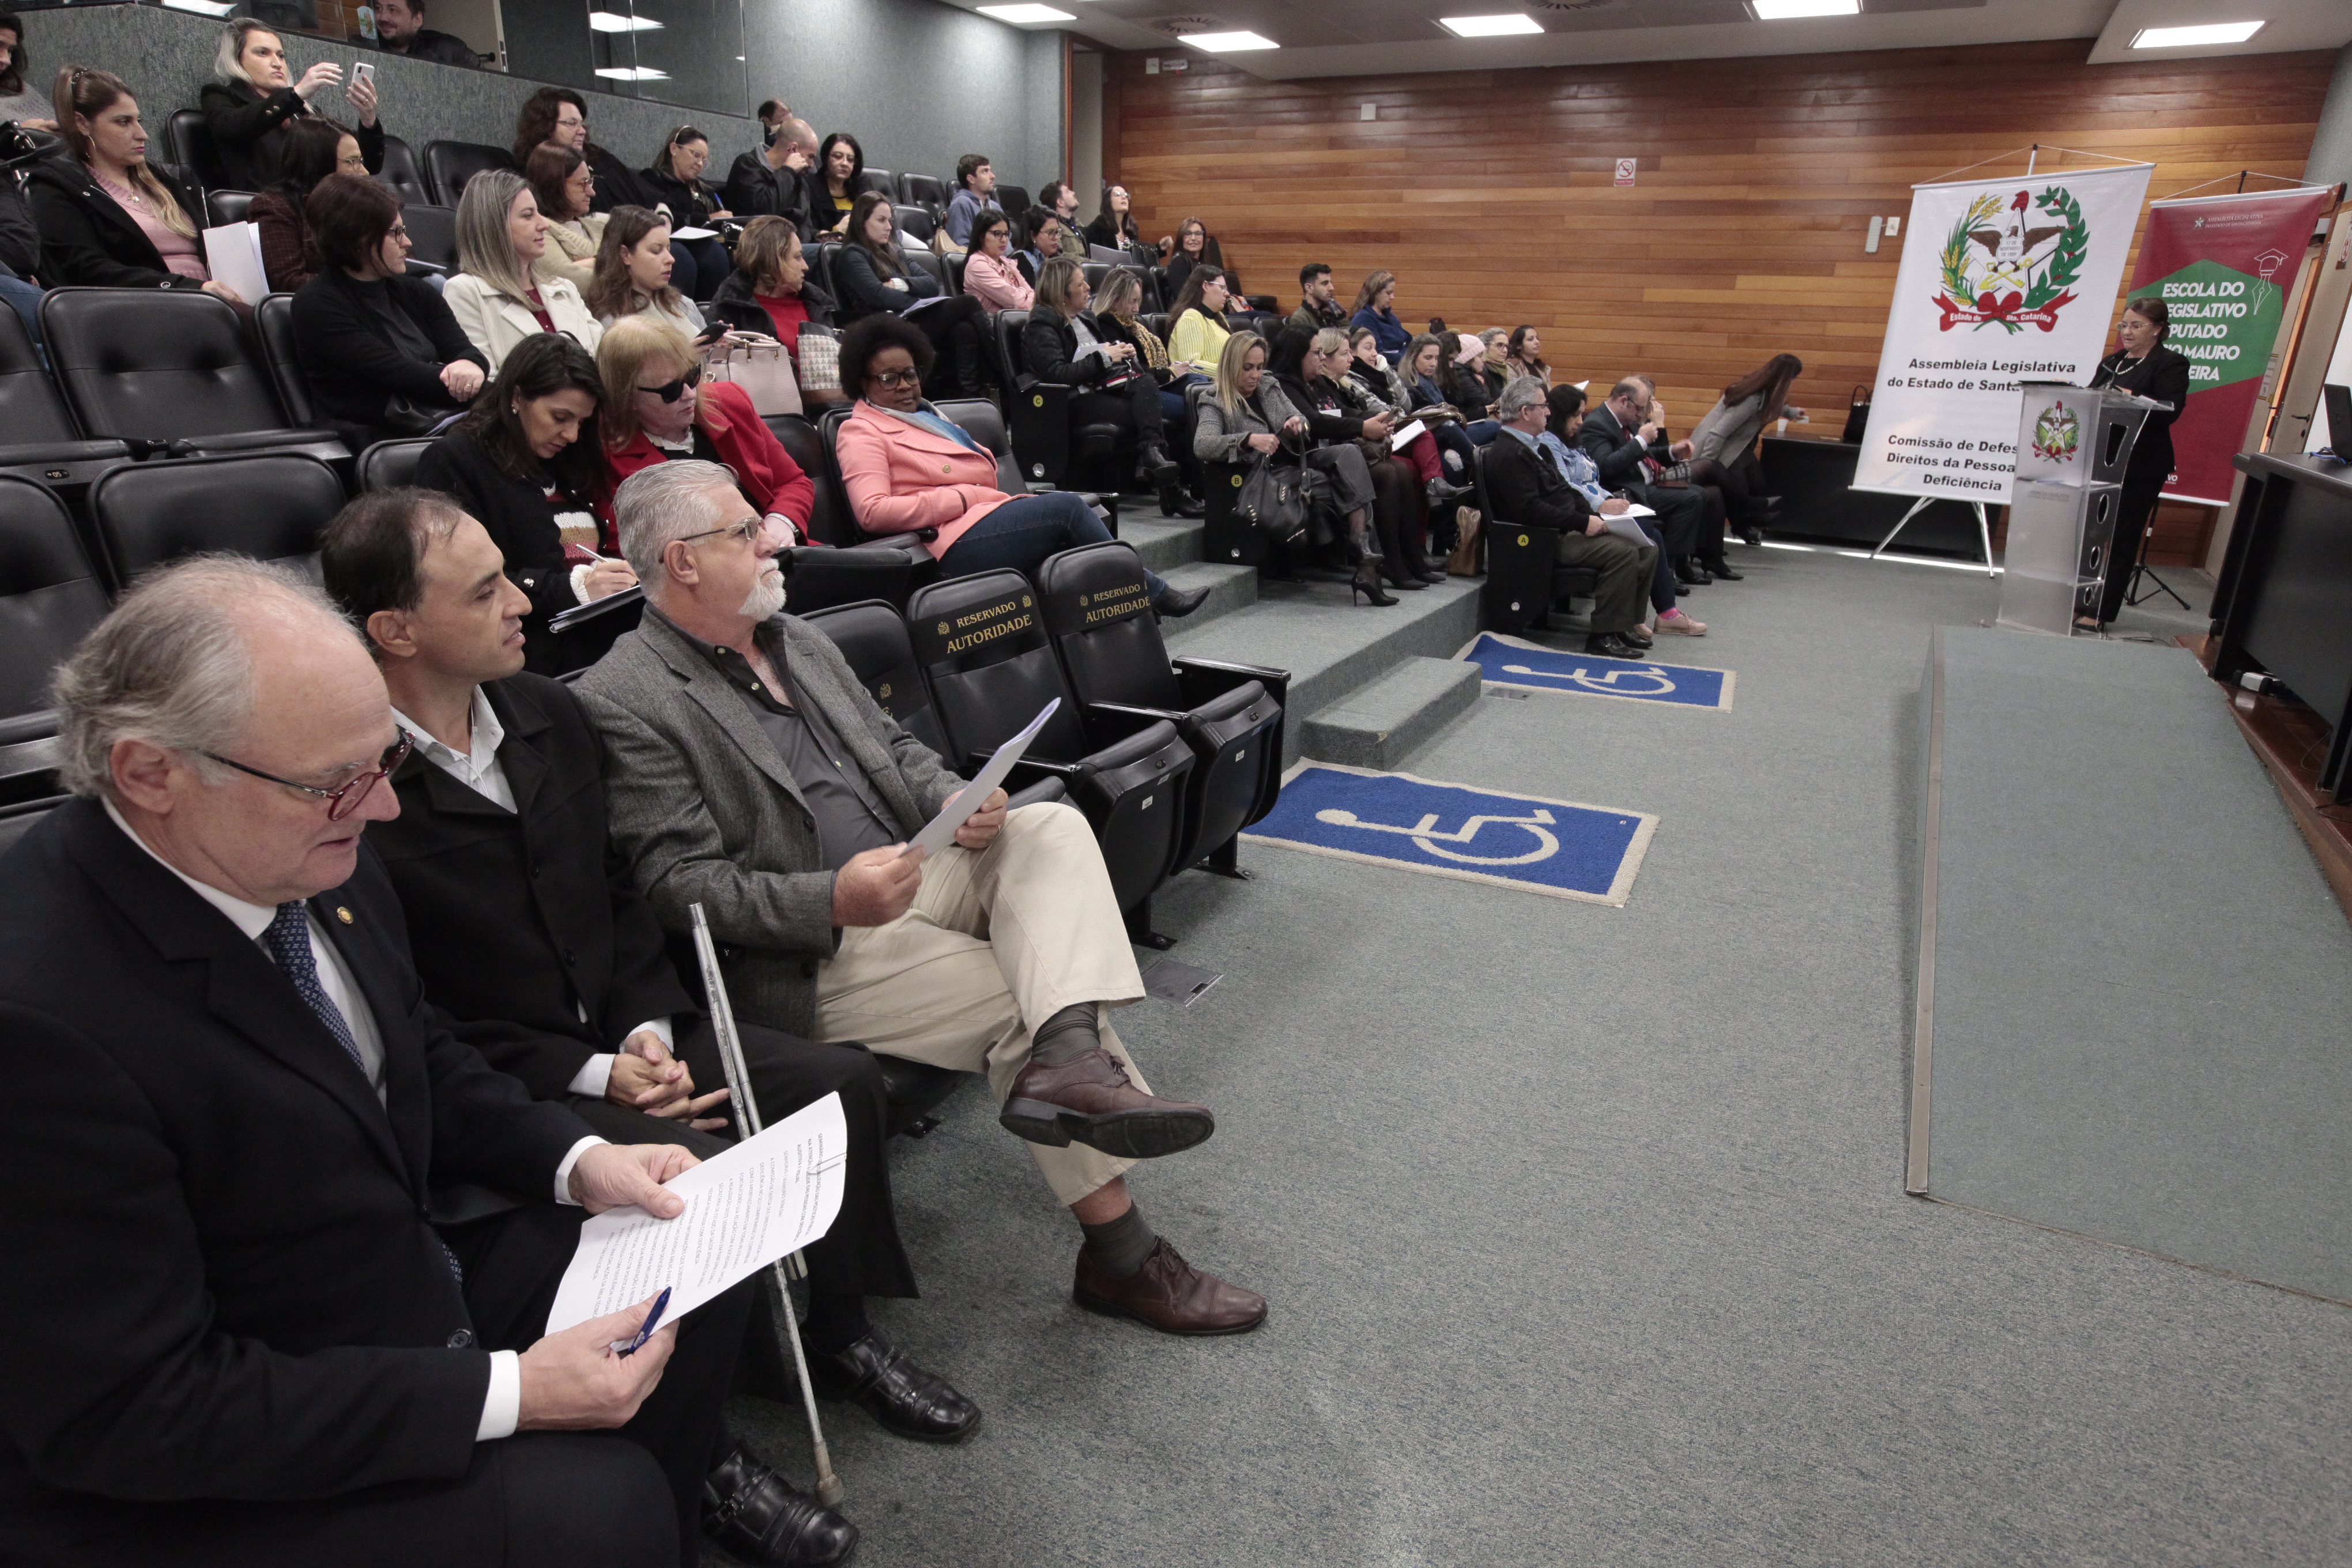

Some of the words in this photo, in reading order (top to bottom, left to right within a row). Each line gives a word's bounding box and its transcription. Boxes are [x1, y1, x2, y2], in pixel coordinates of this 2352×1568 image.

[2162, 282, 2216, 297] ESCOLA
[2218, 281, 2245, 297] DO
[1950, 313, 1972, 322] Estado
[2021, 312, 2052, 323] Catarina
[2167, 303, 2247, 318] EGISLATIVO
[2168, 324, 2228, 339] PUTADO
[2183, 345, 2241, 360] MAURO
[1908, 359, 1987, 371] Assembleia
[1992, 360, 2076, 374] Legislativa
[2188, 365, 2220, 380] EIRA
[1887, 376, 1904, 387] do
[1908, 378, 1954, 389] Estado
[1957, 379, 1974, 390] de
[1888, 435, 1953, 449] Comissão
[1957, 440, 1974, 450] de
[1978, 441, 2018, 454] Defes
[1887, 453, 1938, 466] Direitos
[1943, 457, 1959, 468] da
[1963, 458, 2016, 473] Pessoa
[1923, 473, 2002, 491] Deficiência
[1094, 583, 1141, 602] RESERVADO
[956, 601, 1016, 628] RESERVADO
[1085, 596, 1151, 623] AUTORIDADE
[947, 615, 1032, 654] AUTORIDADE
[615, 1292, 624, 1311] PÚBLICA
